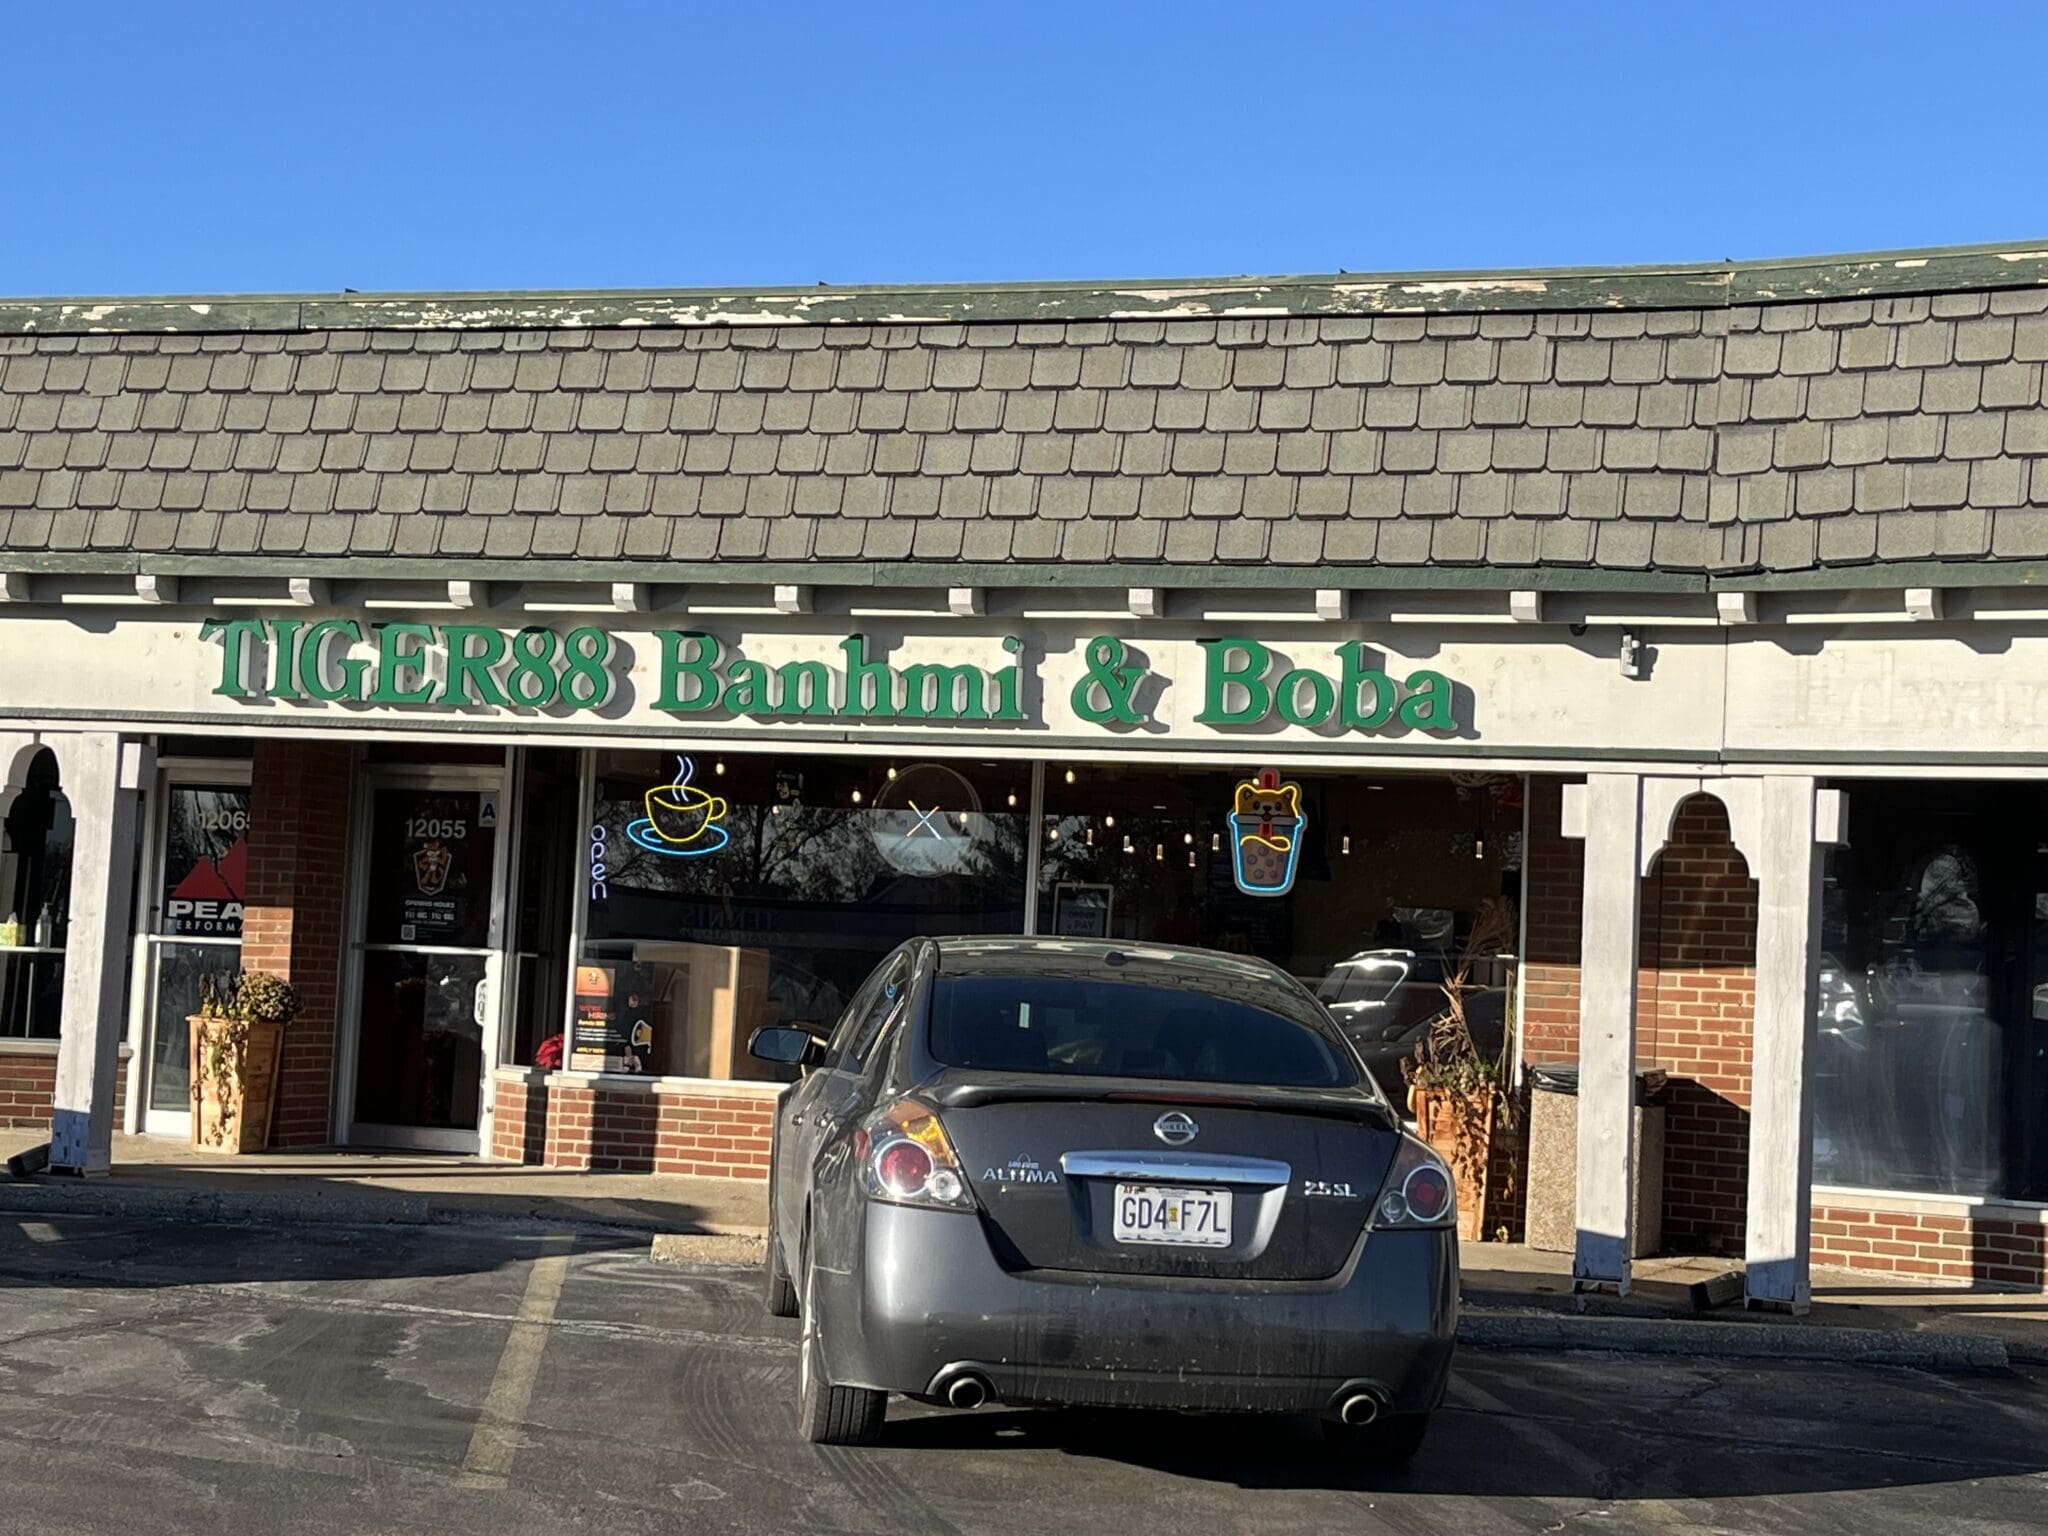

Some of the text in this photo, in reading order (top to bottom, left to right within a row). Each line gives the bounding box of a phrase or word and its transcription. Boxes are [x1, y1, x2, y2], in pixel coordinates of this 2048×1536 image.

[199, 618, 1459, 731] TIGER88 Banhmi & Boba
[481, 803, 496, 819] A
[405, 817, 467, 839] 12055
[590, 824, 608, 900] open
[167, 901, 244, 919] PEA
[982, 1167, 1058, 1183] ALTIMA
[1122, 1197, 1227, 1233] GD4 F7L
